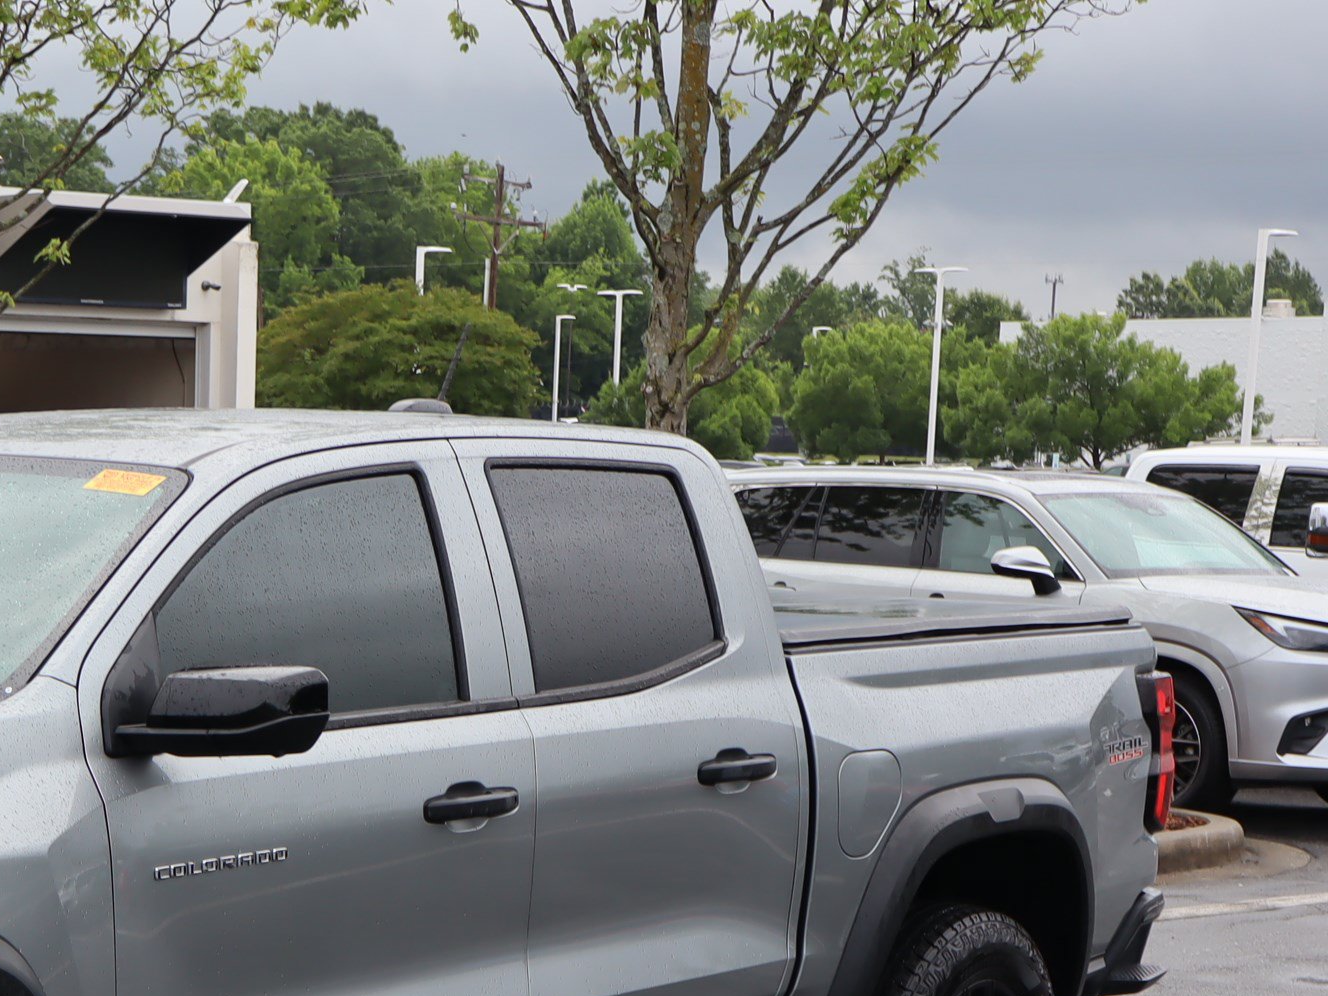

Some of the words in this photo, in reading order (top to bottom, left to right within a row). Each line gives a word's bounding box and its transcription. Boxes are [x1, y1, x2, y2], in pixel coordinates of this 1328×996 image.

[1103, 736, 1149, 755] TRAIL
[1109, 748, 1144, 766] BOSS
[154, 847, 288, 880] COLORADO
